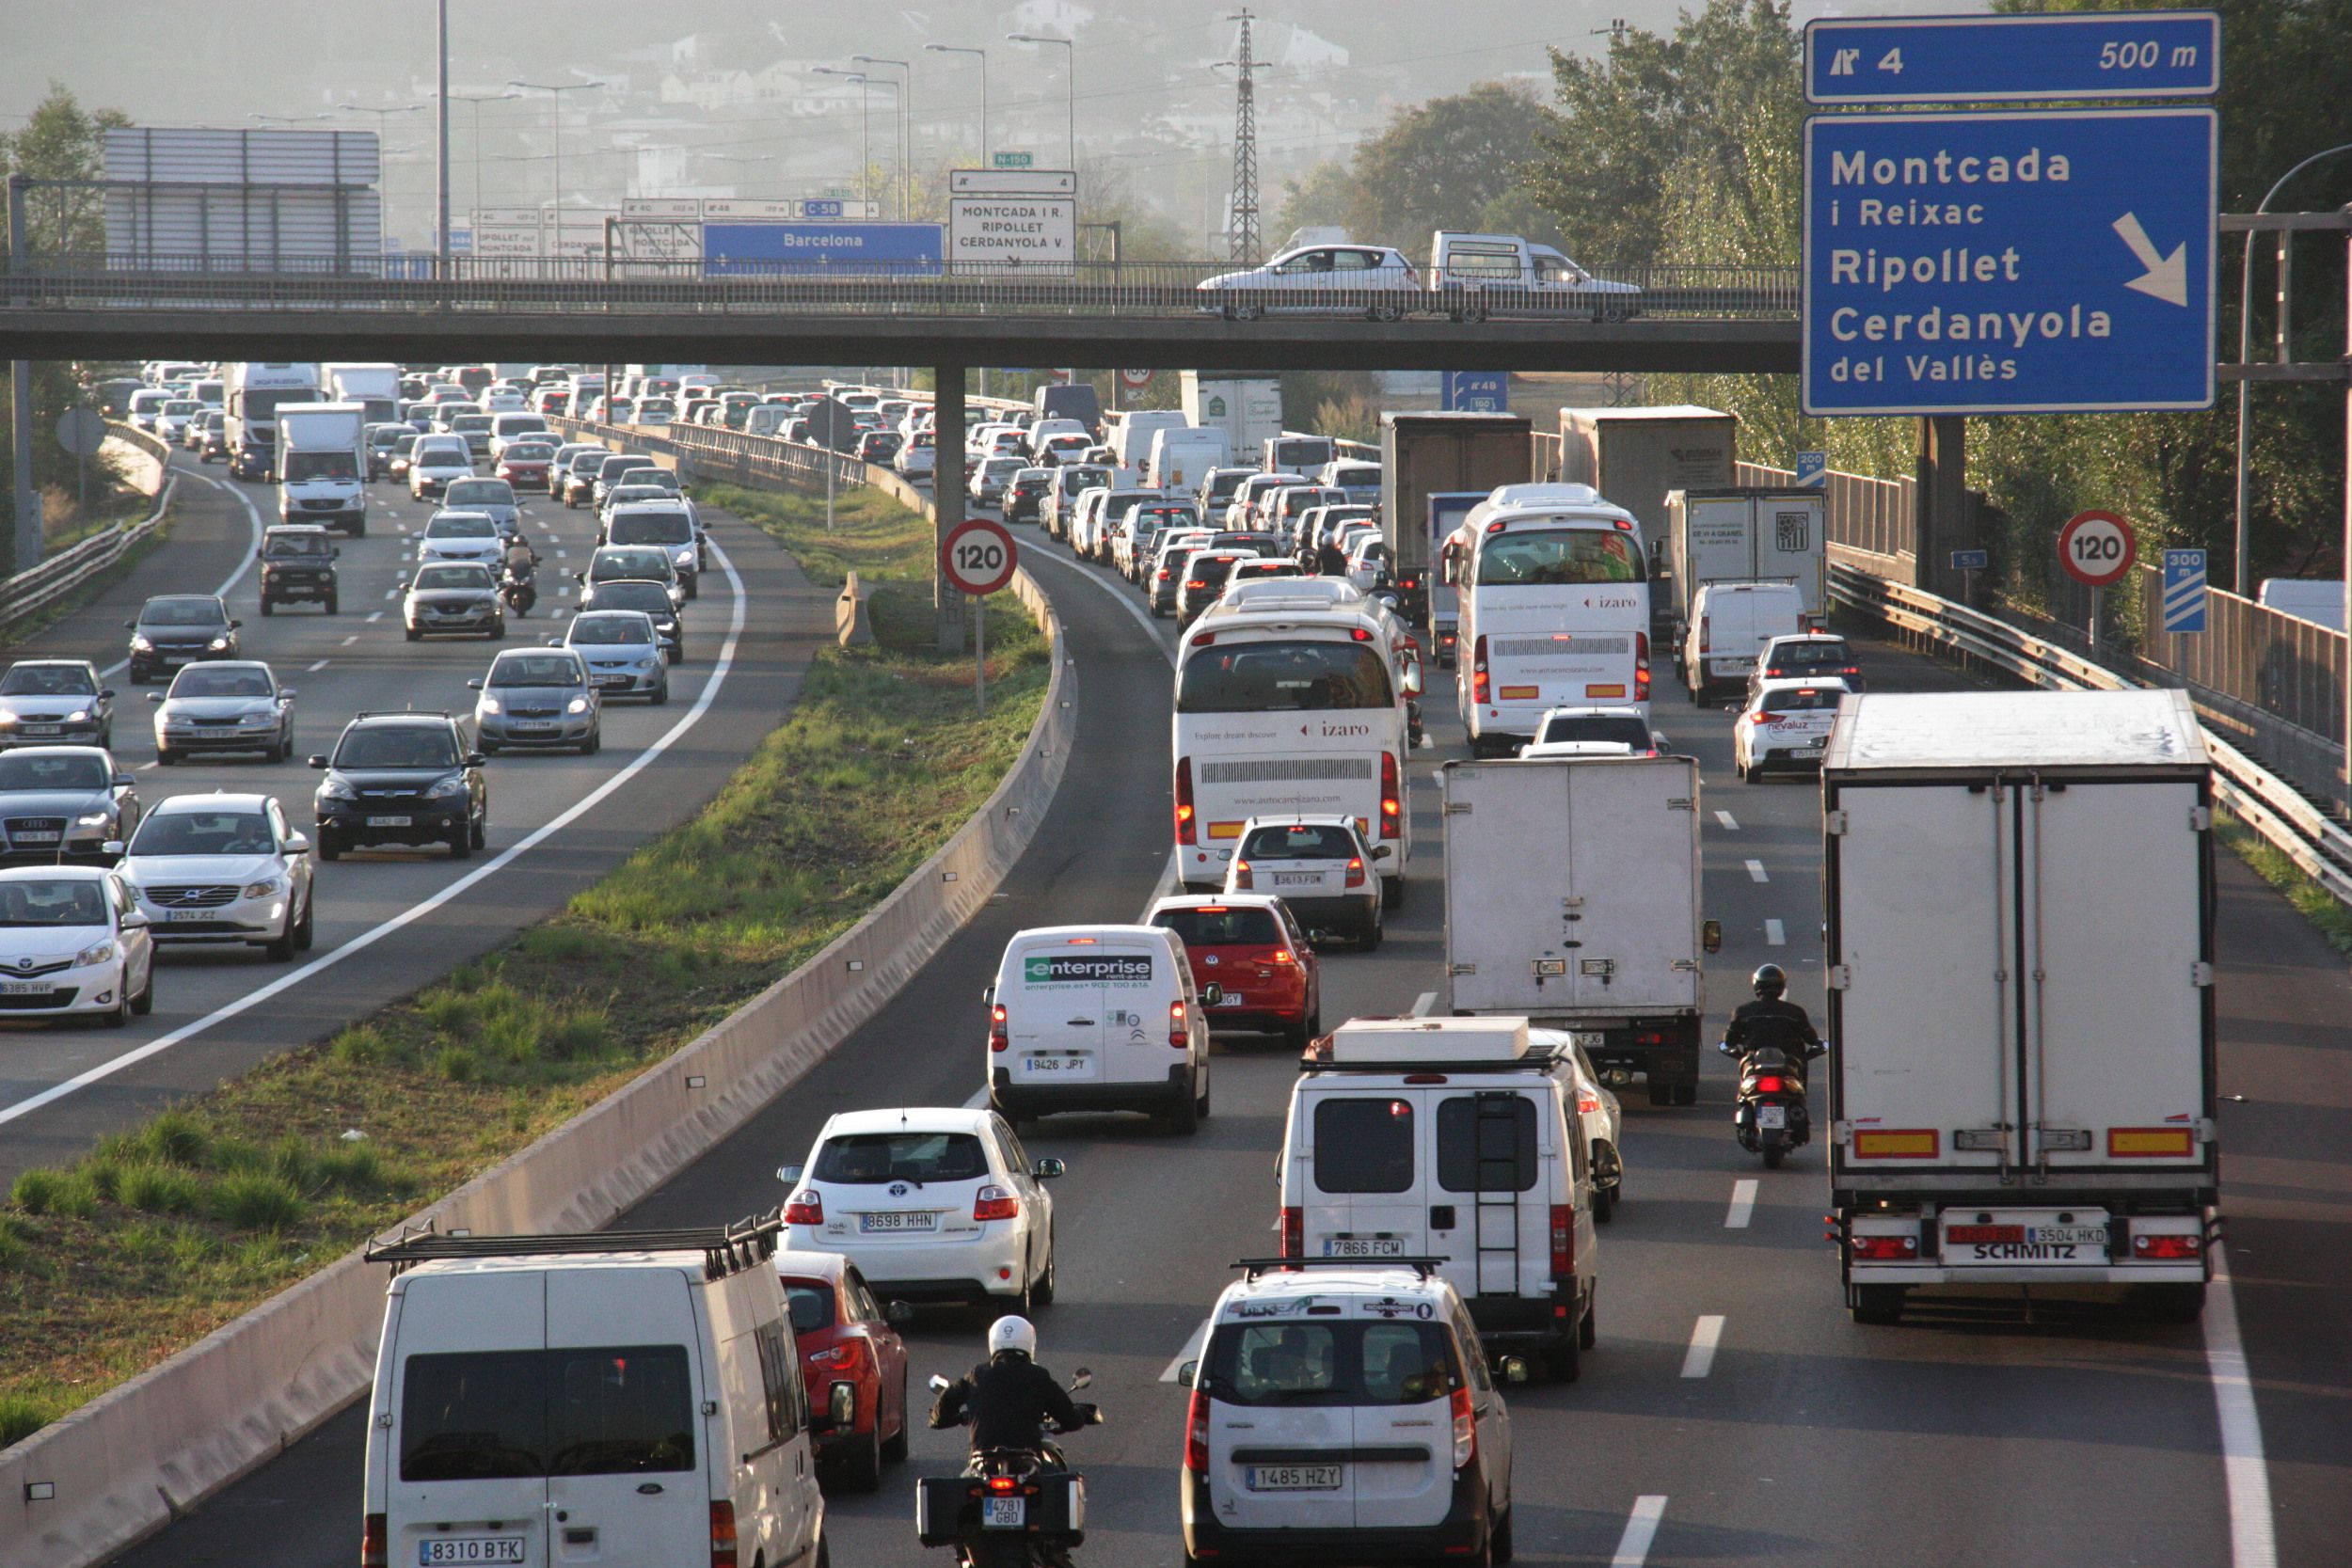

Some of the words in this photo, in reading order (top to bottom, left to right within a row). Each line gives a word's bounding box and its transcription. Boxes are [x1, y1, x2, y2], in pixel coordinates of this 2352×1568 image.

[1878, 47, 1903, 74] 4
[2099, 40, 2159, 71] 500
[2170, 45, 2197, 68] m
[1831, 146, 2071, 186] Montcada
[808, 202, 838, 214] C-58
[962, 207, 1037, 217] MONTCADA
[1052, 207, 1063, 217] R.
[1831, 199, 1839, 226] i
[1860, 197, 1985, 226] Reixac
[982, 222, 1044, 232] RIPOLLET
[784, 233, 864, 247] Barcelona
[960, 237, 1048, 248] CERDANYOLA
[1831, 246, 2020, 293] Ripollet
[1831, 303, 2111, 349] Cerdanyola
[1830, 356, 1883, 382] del
[1906, 353, 2017, 382] Vallès
[1800, 455, 1822, 464] 200
[2074, 535, 2122, 561] 120
[957, 545, 1003, 570] 120
[2169, 554, 2200, 566] 300
[2179, 567, 2191, 577] m
[1599, 595, 1637, 609] izaro
[1321, 721, 1370, 736] izaro
[1768, 721, 1808, 731] nevaluz
[1195, 732, 1221, 741] Explore
[1223, 731, 1247, 739] dream
[1248, 730, 1278, 739] discover
[172, 911, 196, 921] 2574
[1031, 959, 1151, 977] enterprise
[1033, 1059, 1059, 1070] 9426
[1065, 1059, 1085, 1070] JPY
[867, 1214, 900, 1227] 8698
[907, 1213, 932, 1227] HHN
[2039, 1228, 2074, 1243] 3504
[2077, 1229, 2105, 1243] HKD
[1334, 1242, 1369, 1255] 7866
[1975, 1244, 2077, 1259] SCHMITZ
[1261, 1469, 1300, 1485] 1485
[1305, 1469, 1337, 1484] HZY
[433, 1542, 479, 1560] 8310
[485, 1542, 518, 1559] BTK
